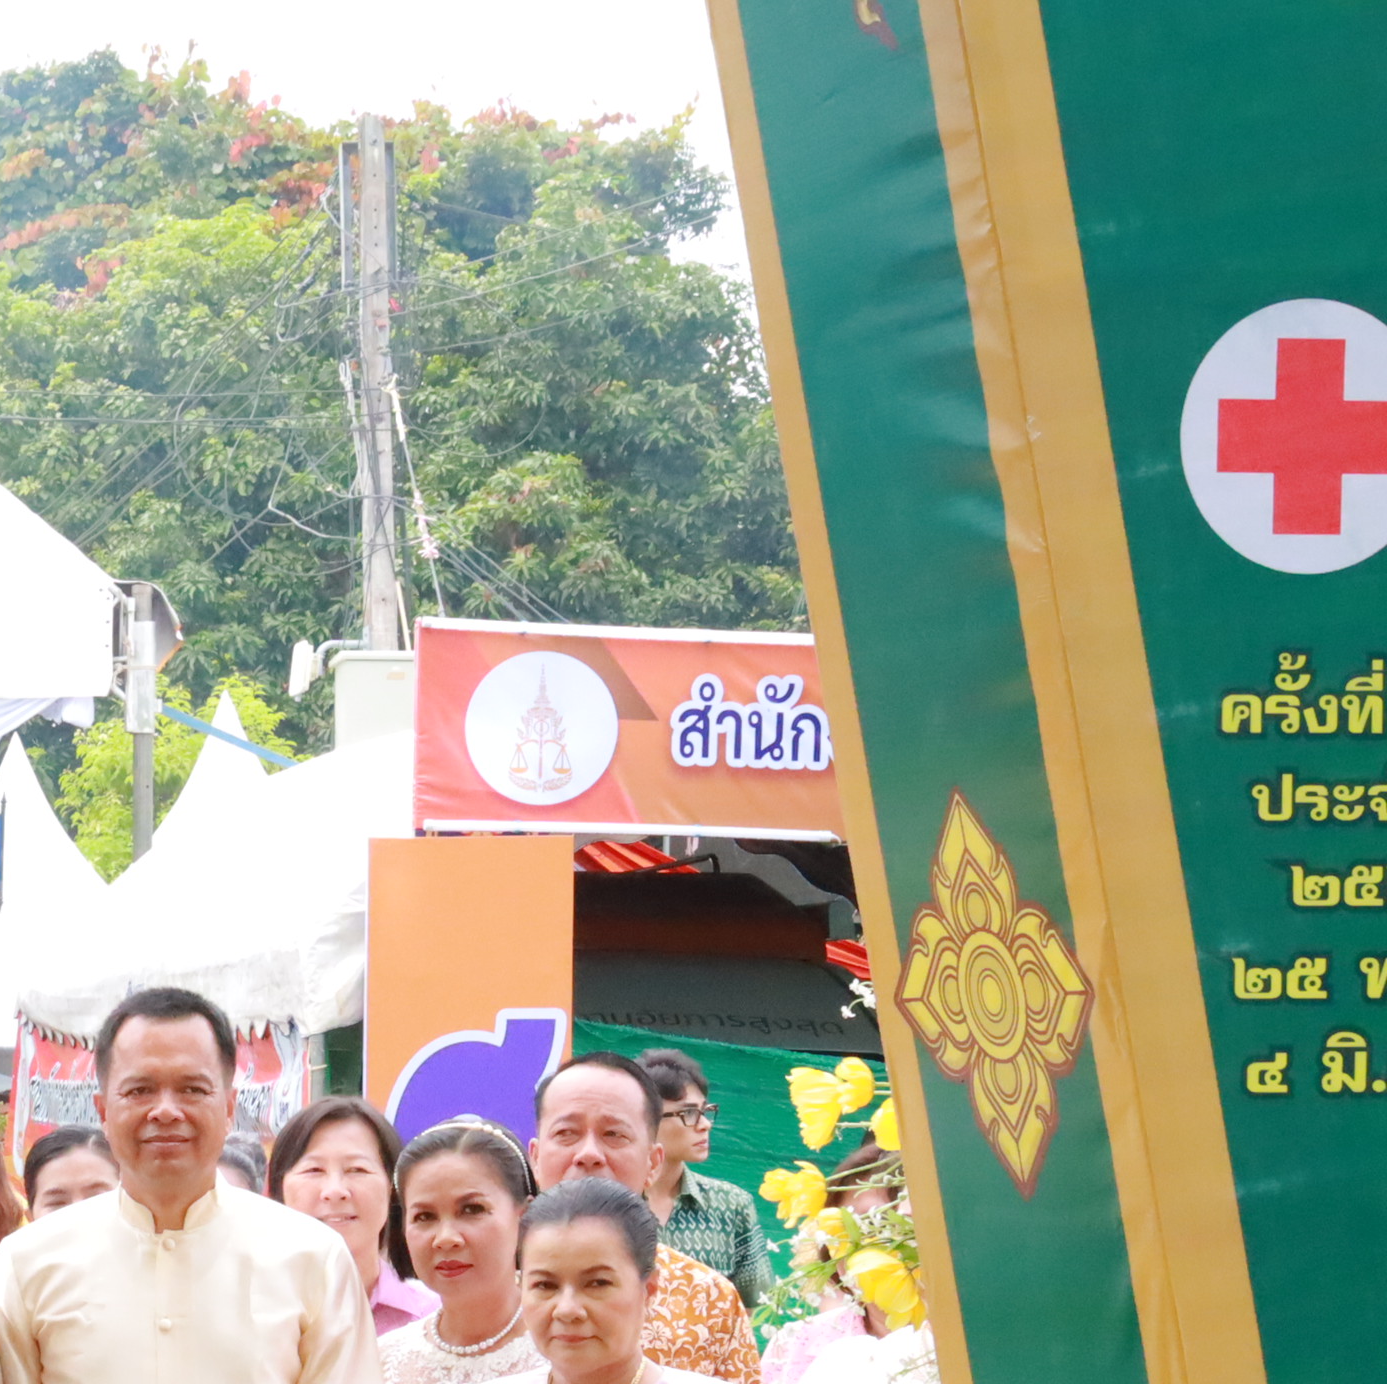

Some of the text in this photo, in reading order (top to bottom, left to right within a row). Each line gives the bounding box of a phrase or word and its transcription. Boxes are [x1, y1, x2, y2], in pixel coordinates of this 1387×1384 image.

[679, 682, 830, 764] สำนัก
[1221, 652, 1385, 734] ครั้งที่
[1291, 865, 1384, 907] ๒๕
[1233, 957, 1328, 1000] ๒๕
